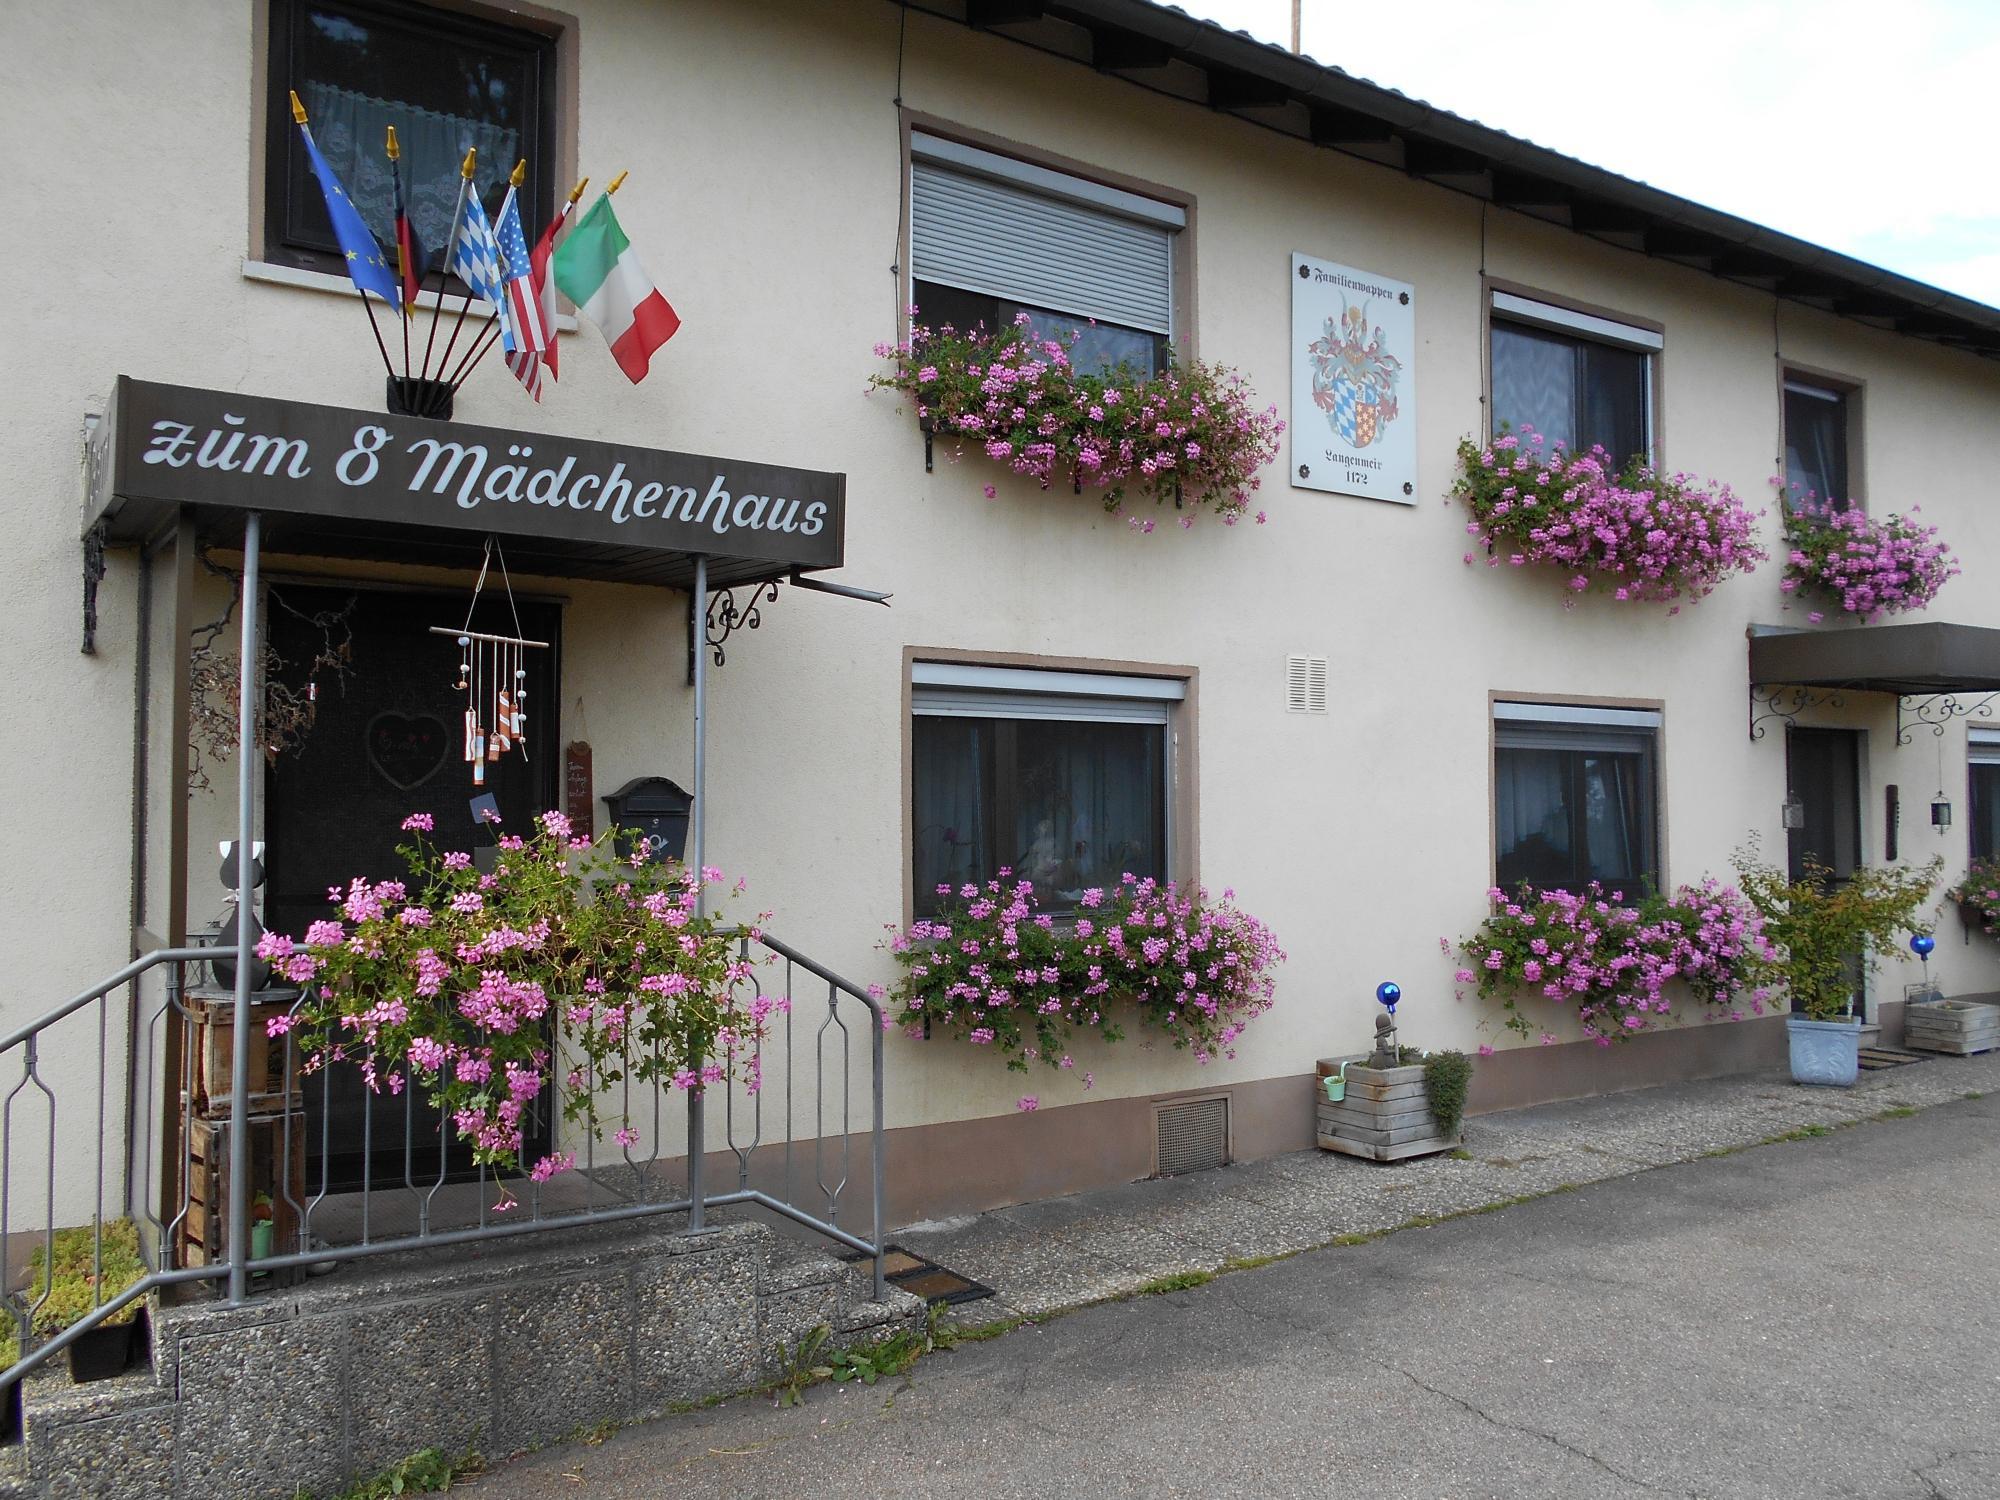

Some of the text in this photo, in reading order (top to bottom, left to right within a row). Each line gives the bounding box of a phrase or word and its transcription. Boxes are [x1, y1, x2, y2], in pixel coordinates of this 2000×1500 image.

[1314, 267, 1393, 299] Familienwappen
[335, 425, 394, 486] 8
[407, 439, 827, 535] Mädchenhaus
[1346, 471, 1368, 485] 1172
